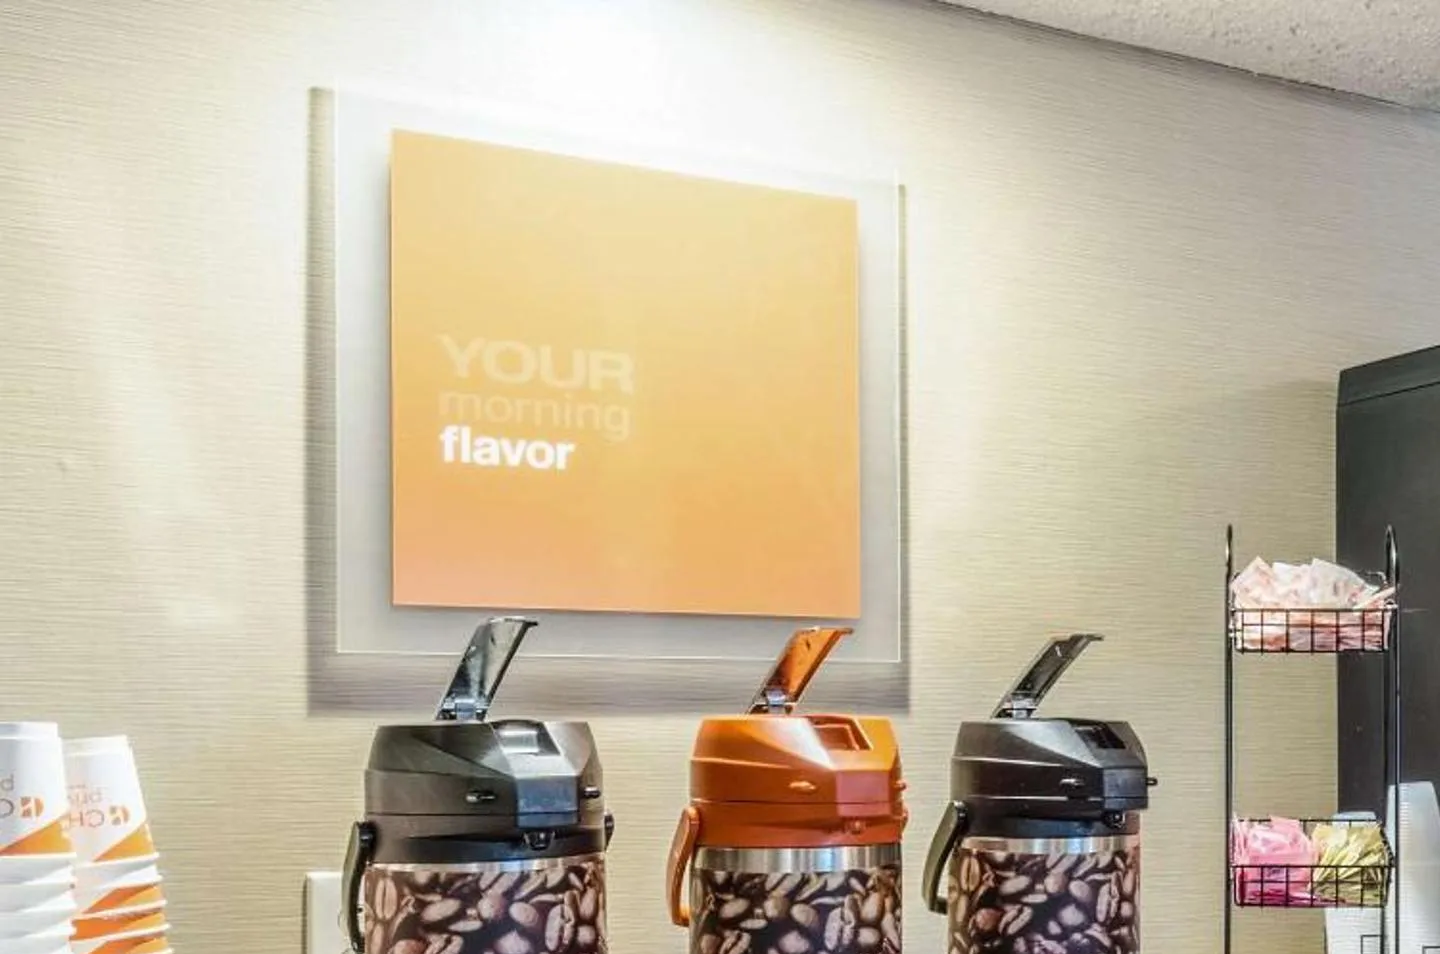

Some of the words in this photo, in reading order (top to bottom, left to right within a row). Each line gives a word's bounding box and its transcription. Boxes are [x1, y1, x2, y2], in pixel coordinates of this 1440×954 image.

[437, 334, 635, 394] YOUR
[439, 391, 631, 442] morning
[439, 425, 576, 470] flavor
